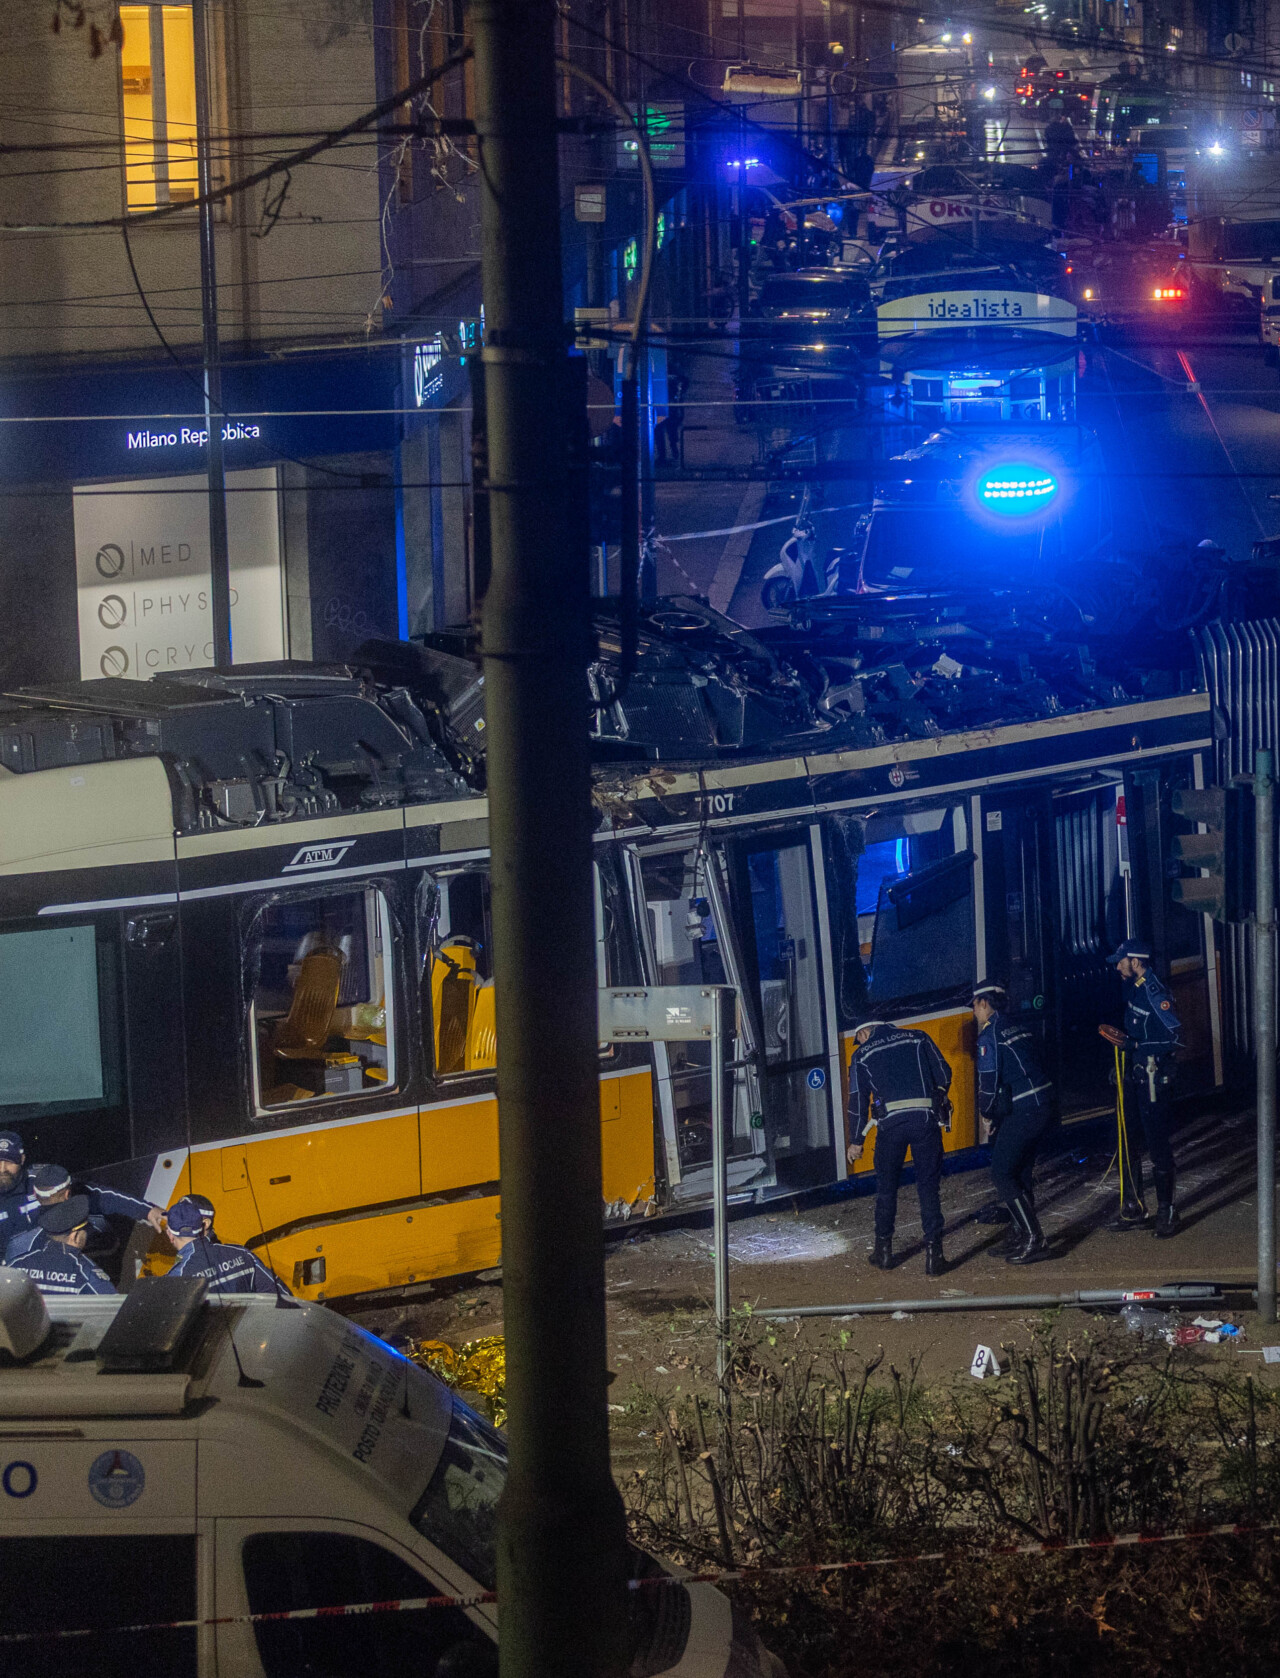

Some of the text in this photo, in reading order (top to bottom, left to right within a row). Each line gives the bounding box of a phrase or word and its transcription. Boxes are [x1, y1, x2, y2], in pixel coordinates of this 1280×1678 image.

[928, 298, 1022, 317] idealista
[127, 422, 260, 449] Milano Repblica
[140, 543, 192, 566] MED
[142, 587, 239, 617] PHYSO
[303, 848, 334, 864] ATM
[975, 1349, 985, 1368] 8
[314, 1353, 355, 1418] PROTEZIONE
[351, 1422, 381, 1463] POSTO
